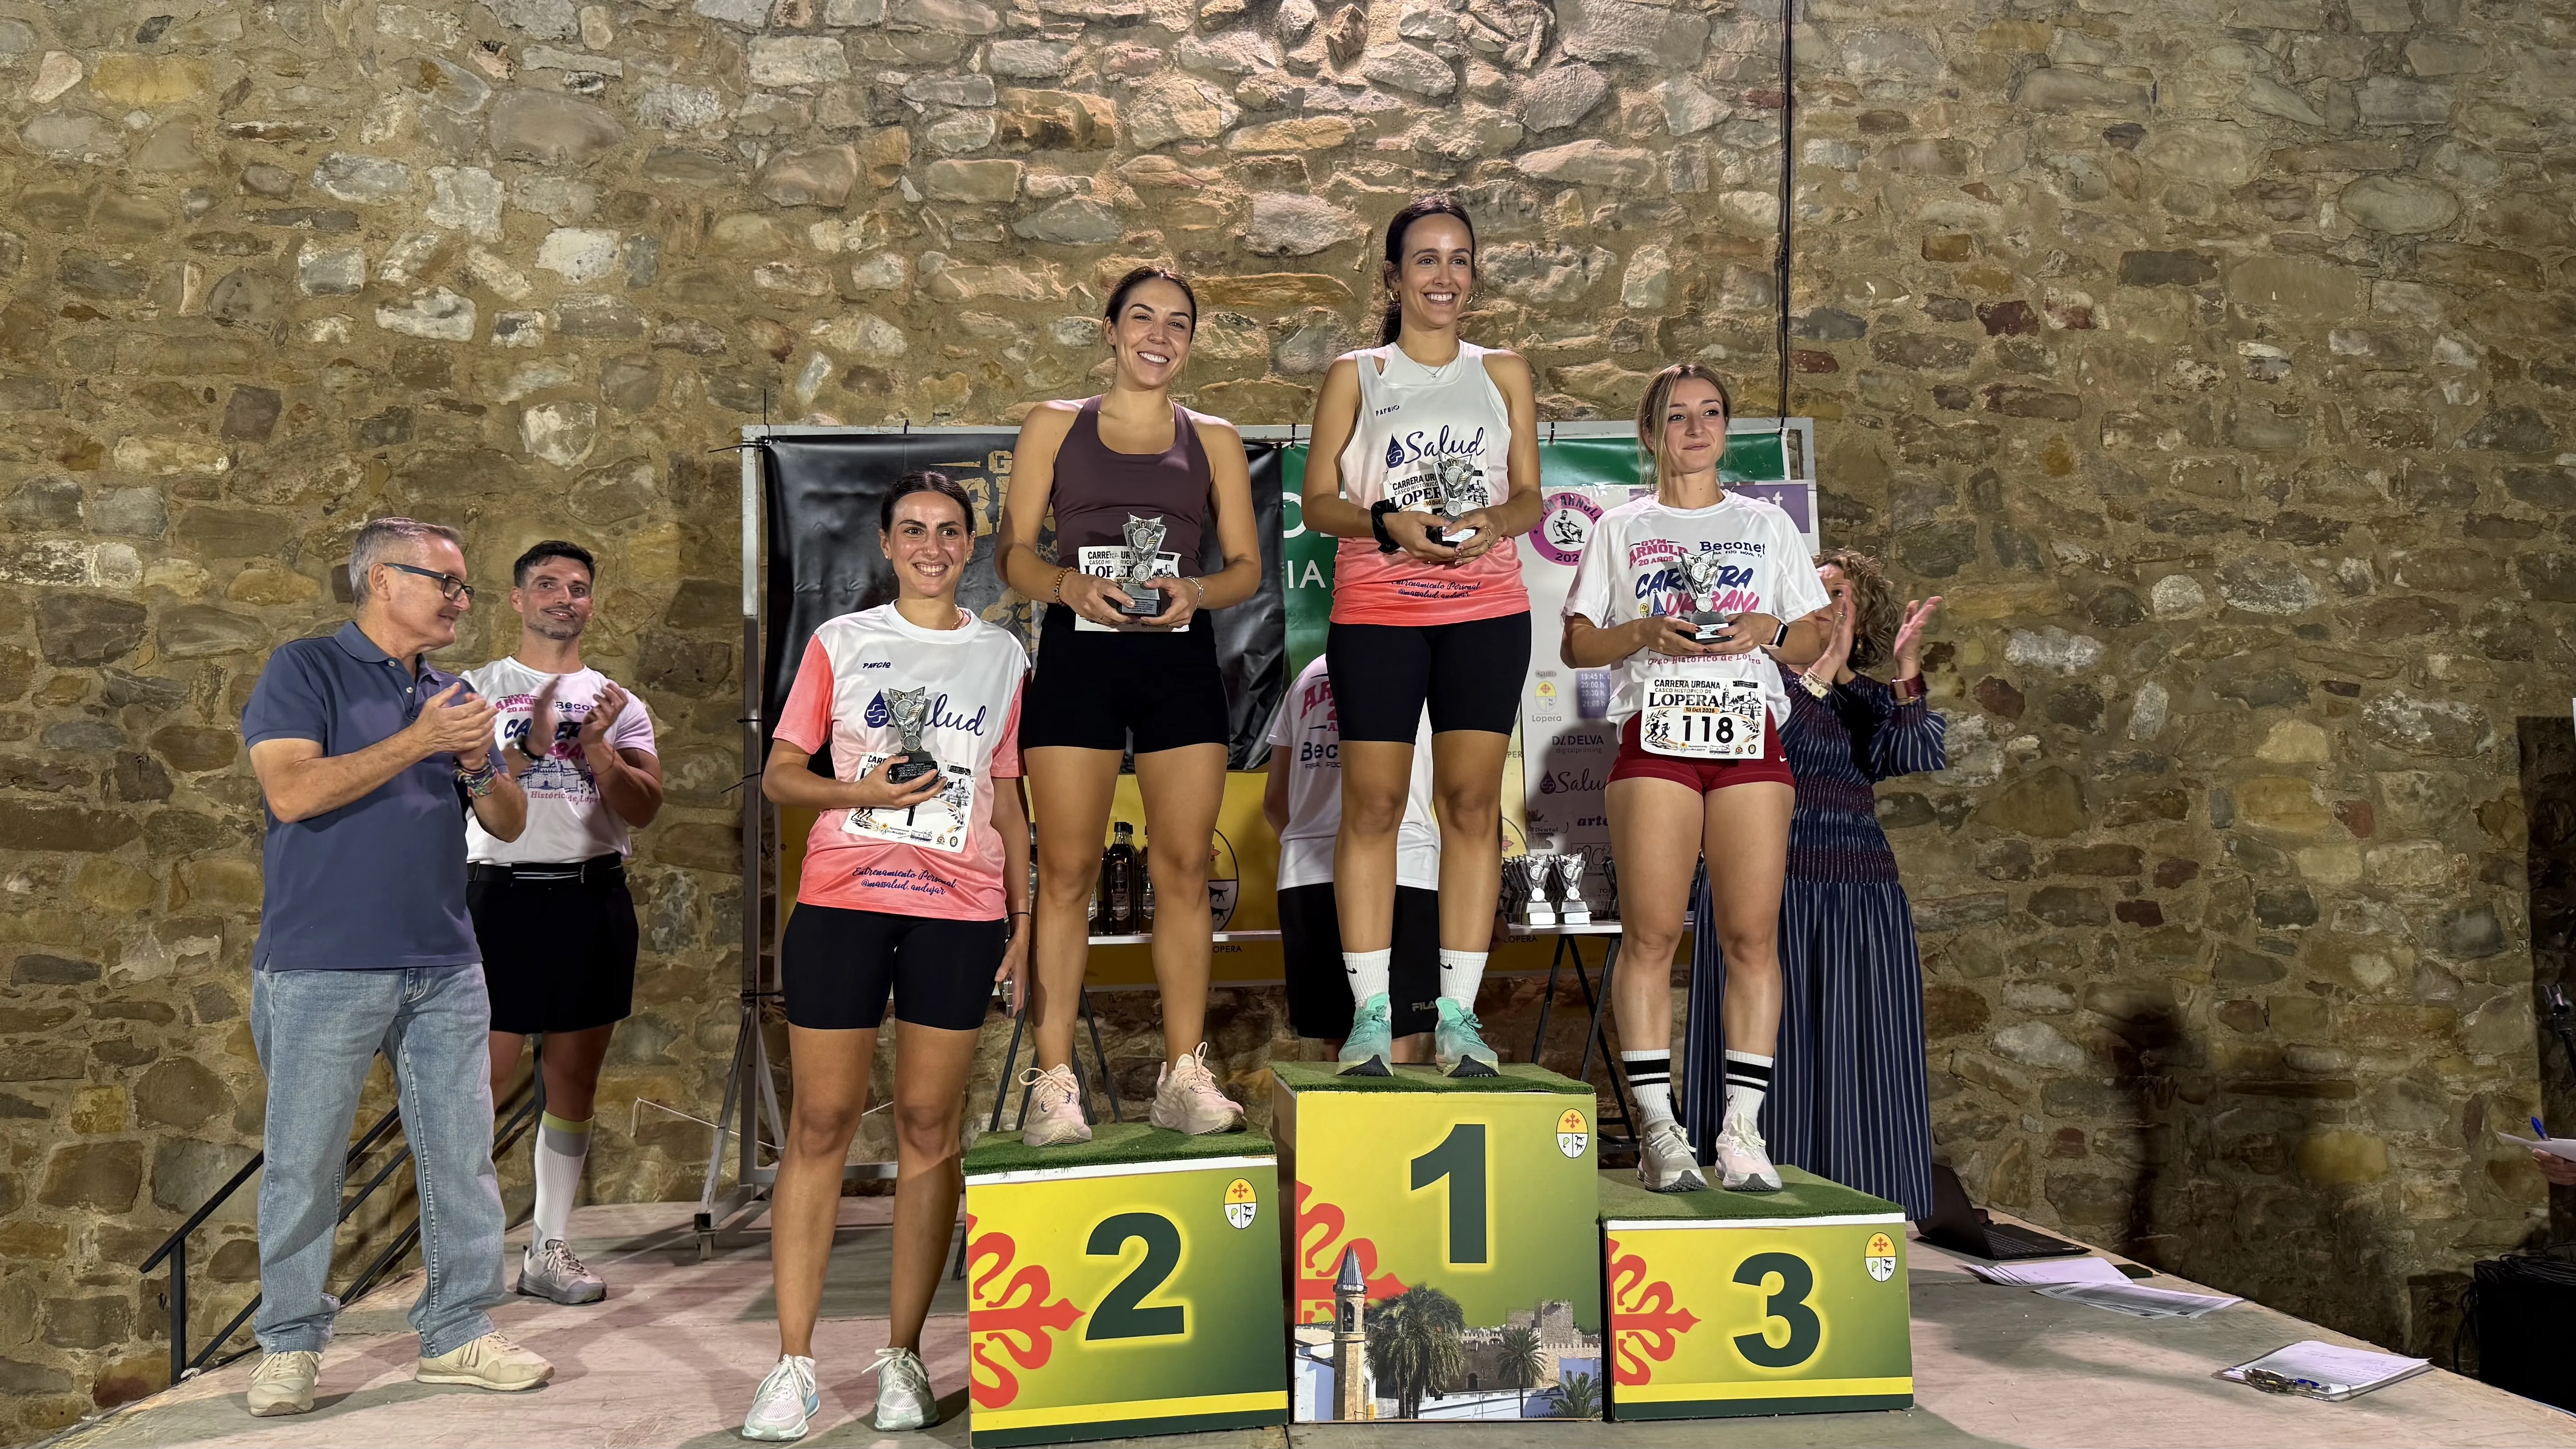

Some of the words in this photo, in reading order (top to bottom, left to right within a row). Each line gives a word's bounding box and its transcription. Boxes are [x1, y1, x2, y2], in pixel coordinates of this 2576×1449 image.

[1404, 425, 1485, 464] Salud
[1393, 476, 1423, 491] CARRERA
[1391, 488, 1442, 508] LOPER
[1394, 487, 1410, 496] CASCO
[1699, 542, 1765, 555] Beconet
[1555, 552, 1579, 562] 202
[1084, 565, 1133, 578] LOPER
[1635, 565, 1754, 599] CARRA
[1655, 679, 1689, 688] CARRERA
[1691, 681, 1720, 689] URBANA
[496, 698, 534, 711] ARNO
[555, 701, 594, 711] Beco
[1647, 692, 1720, 708] LOPERA
[887, 694, 986, 736] lud
[1532, 715, 1561, 723] Lopera
[1683, 715, 1734, 744] 118
[852, 866, 916, 878] Entrenamiento
[918, 869, 957, 888] Personal
[1412, 1000, 1436, 1012] FILA
[1410, 1123, 1487, 1264] 1
[1085, 1212, 1184, 1341] 2
[1732, 1252, 1821, 1368] 3
